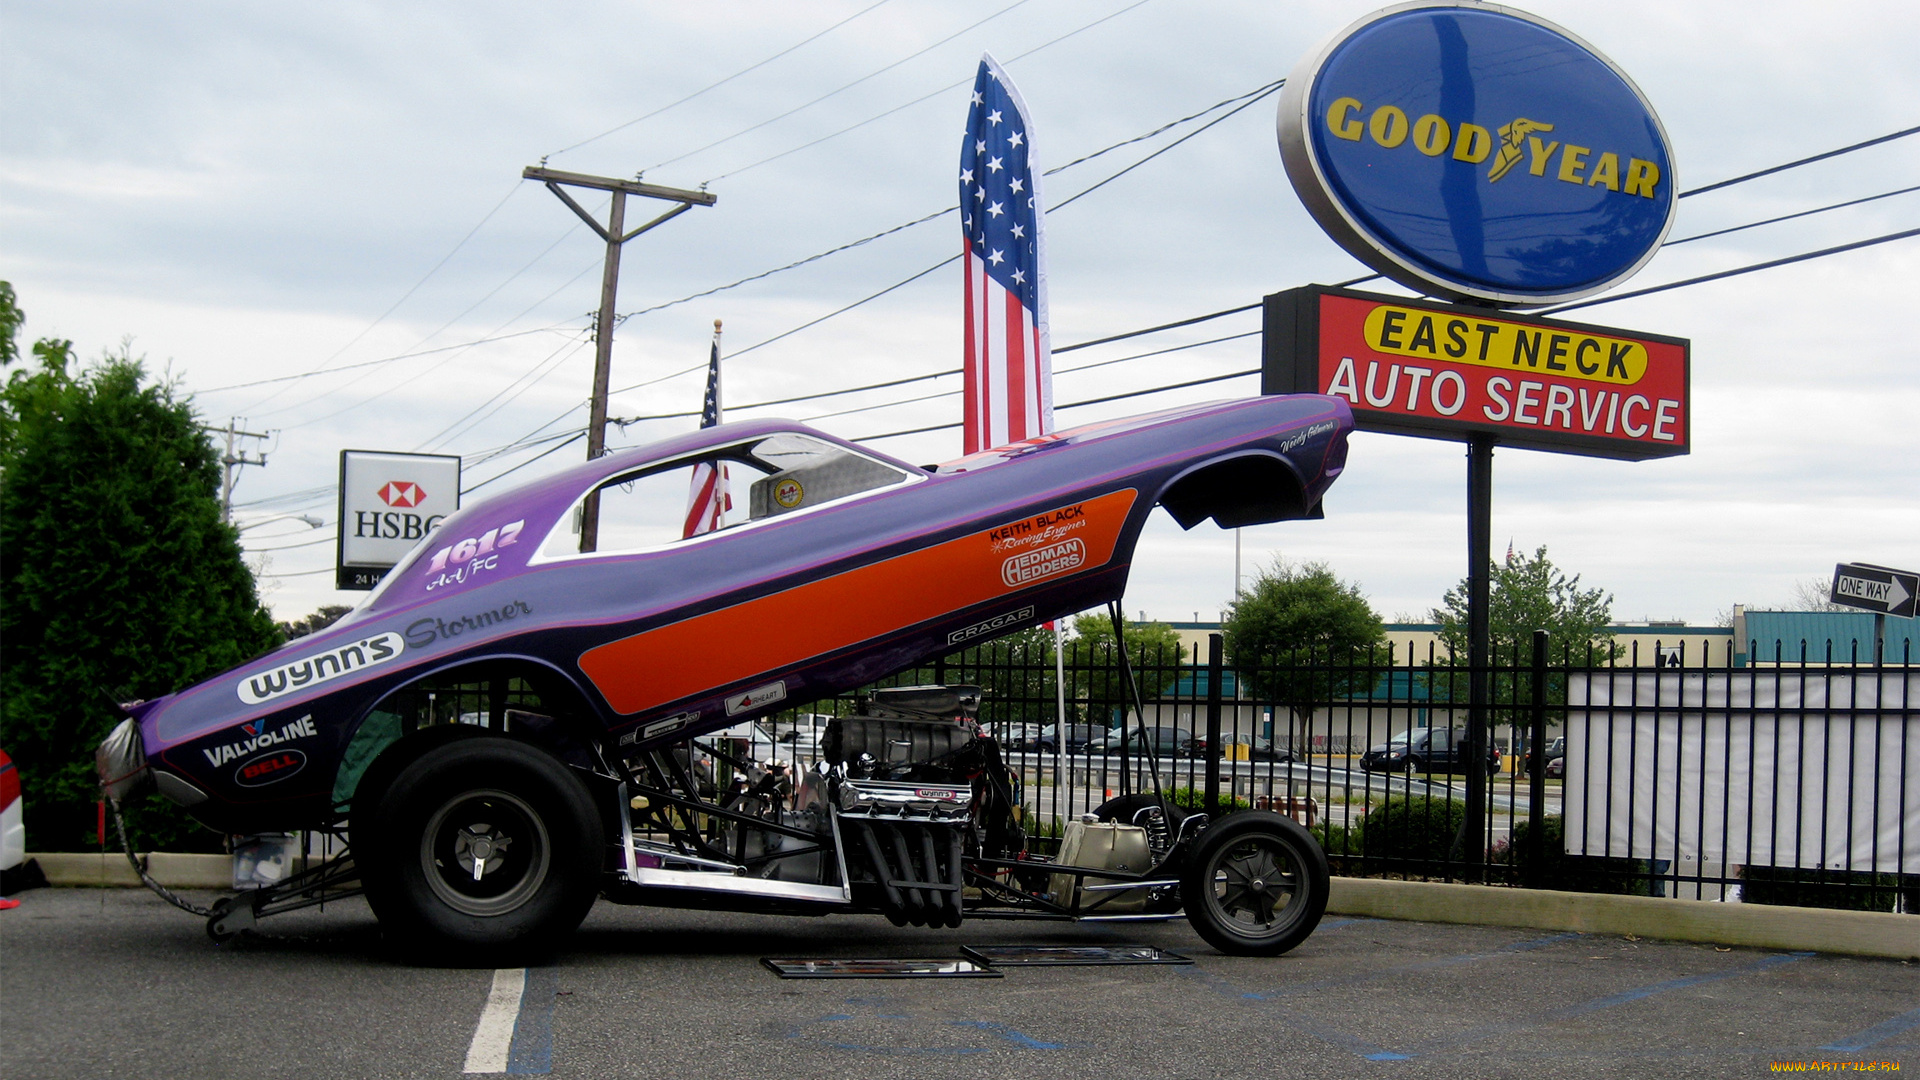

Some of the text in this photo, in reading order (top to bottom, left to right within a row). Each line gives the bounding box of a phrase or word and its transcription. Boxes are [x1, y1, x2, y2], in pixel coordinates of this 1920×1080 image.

[1326, 97, 1660, 199] GOODYEAR
[1379, 310, 1634, 380] EAST NECK
[1326, 357, 1679, 441] AUTO SERVICE
[989, 505, 1085, 542] KEITH BLACK
[1002, 518, 1087, 550] Racing Engines
[425, 519, 525, 576] 1617
[1006, 541, 1078, 578] HEDMAN
[355, 574, 368, 585] 24
[1006, 553, 1080, 584] HEDDERS
[1840, 577, 1891, 600] ONE WAY
[405, 600, 533, 648] Stormer
[951, 609, 1031, 642] CRAGAR
[203, 714, 318, 768] VALVOLINE
[243, 755, 298, 779] BELL
